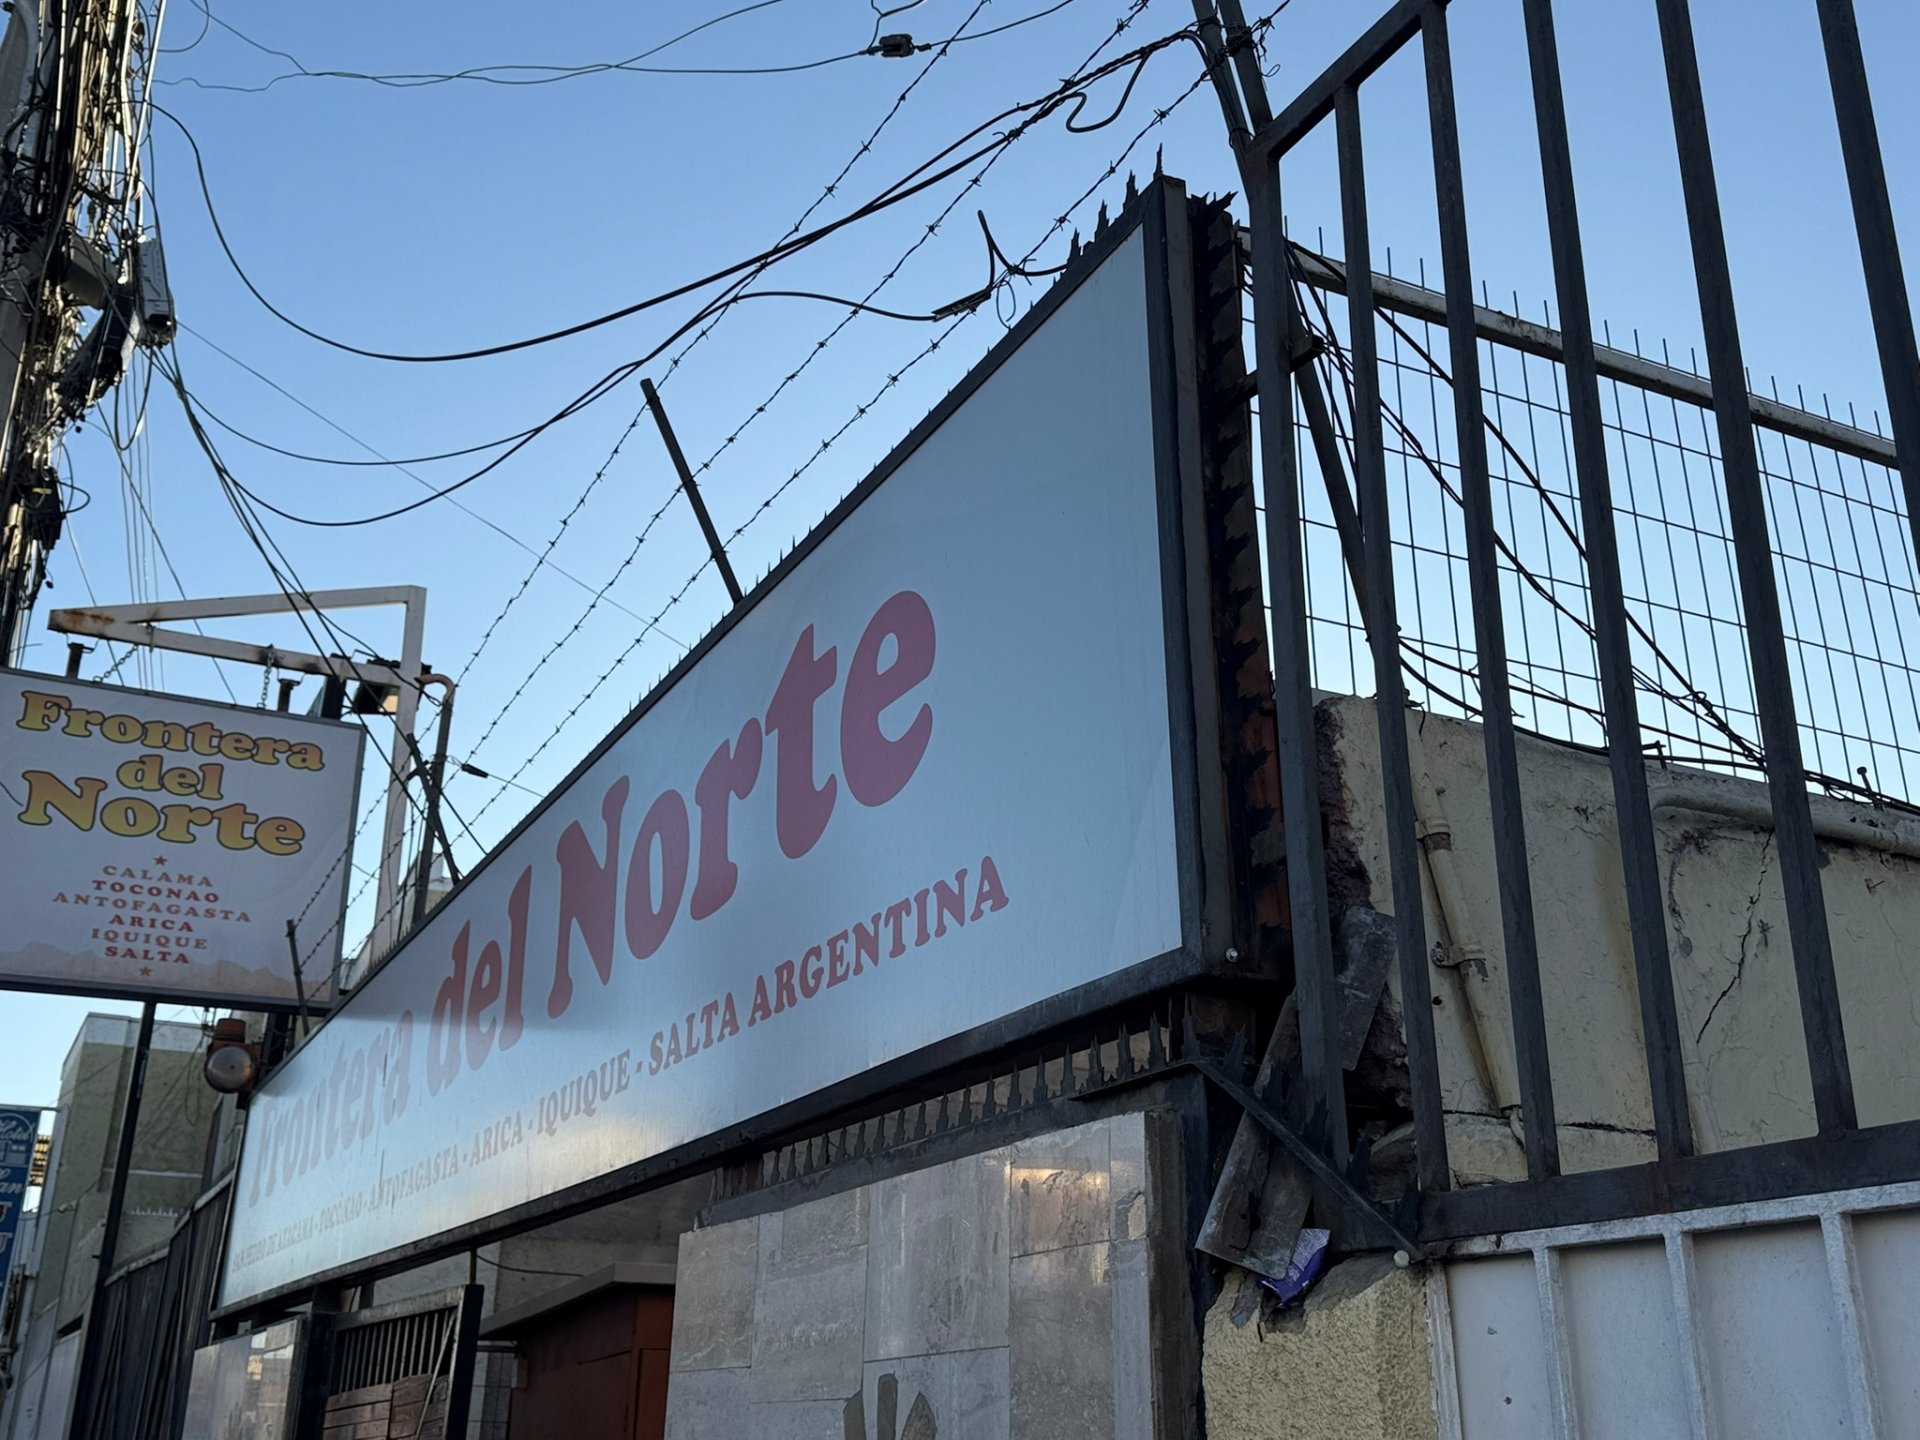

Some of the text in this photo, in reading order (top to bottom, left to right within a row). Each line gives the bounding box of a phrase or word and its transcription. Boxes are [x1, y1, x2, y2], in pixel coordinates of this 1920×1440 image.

[16, 690, 326, 772] Frontera
[116, 754, 224, 800] del
[17, 770, 306, 856] Norte
[92, 879, 220, 903] TOCONAO
[102, 865, 213, 887] CALAMA
[53, 892, 251, 922] ANTOFAGASTA
[248, 590, 936, 1208] Frontera del Norte
[108, 914, 194, 932] ARICA
[91, 928, 208, 949] IQUIQUE
[105, 946, 190, 964] SALTA
[368, 1144, 459, 1212] ANTOFAGASTA
[470, 1110, 523, 1167] ARICA
[536, 1048, 630, 1137] IQUIQUE
[649, 992, 740, 1076] SALTA
[748, 855, 1009, 1027] ARGENTINA
